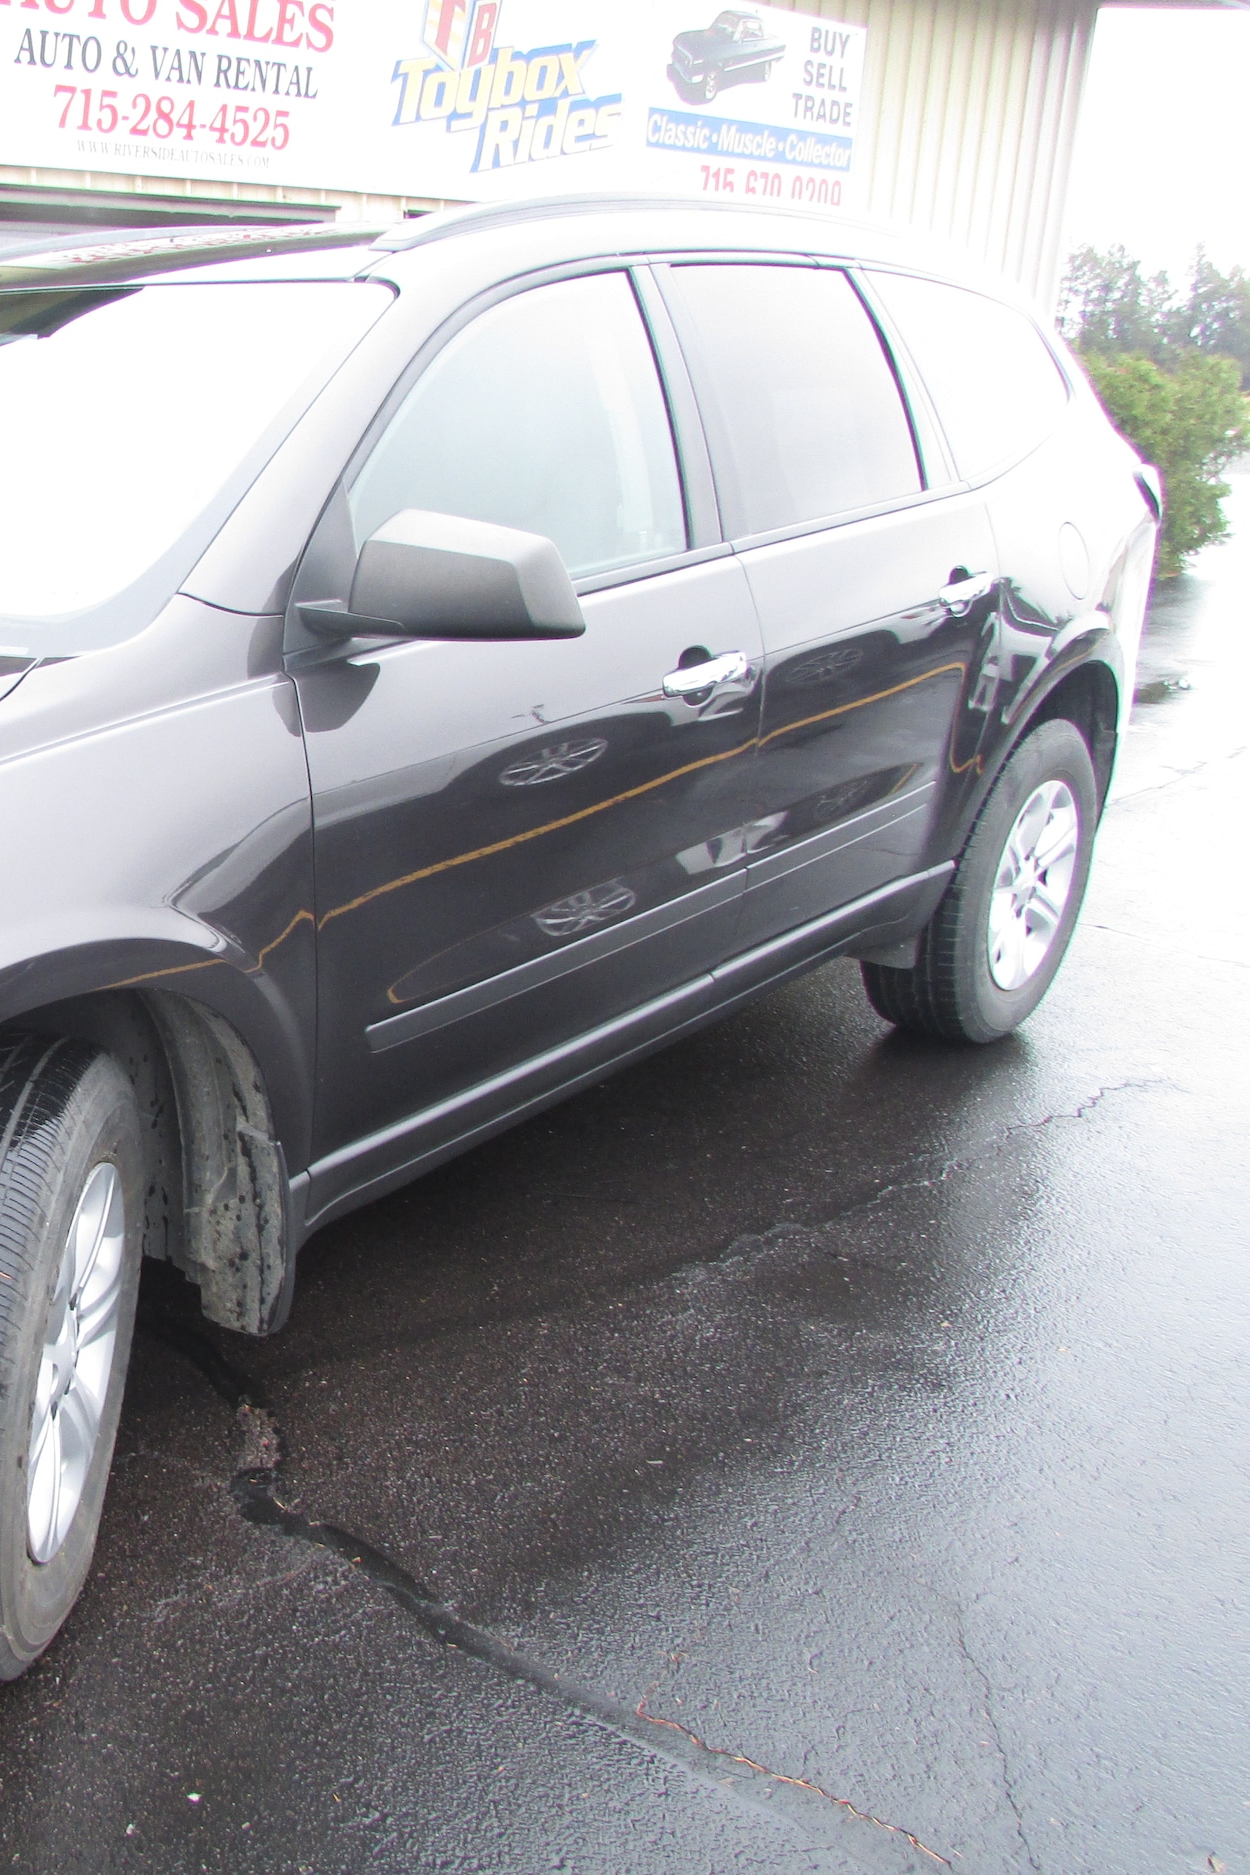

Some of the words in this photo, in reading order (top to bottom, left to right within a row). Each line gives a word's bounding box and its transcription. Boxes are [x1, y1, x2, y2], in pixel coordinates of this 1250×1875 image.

[175, 0, 334, 52] SALES
[809, 26, 851, 59] BUY
[14, 28, 102, 73] AUTO
[112, 40, 139, 78] &
[150, 45, 207, 86] VAN
[213, 54, 319, 99] RENTAL
[393, 43, 595, 132] Toybox
[803, 59, 848, 93] SELL
[53, 84, 291, 150] 715-284-4525
[473, 96, 624, 172] Rides
[792, 92, 853, 127] TRADE
[647, 113, 710, 150] Classic
[717, 123, 778, 158] Muscle
[785, 133, 852, 168] Collector
